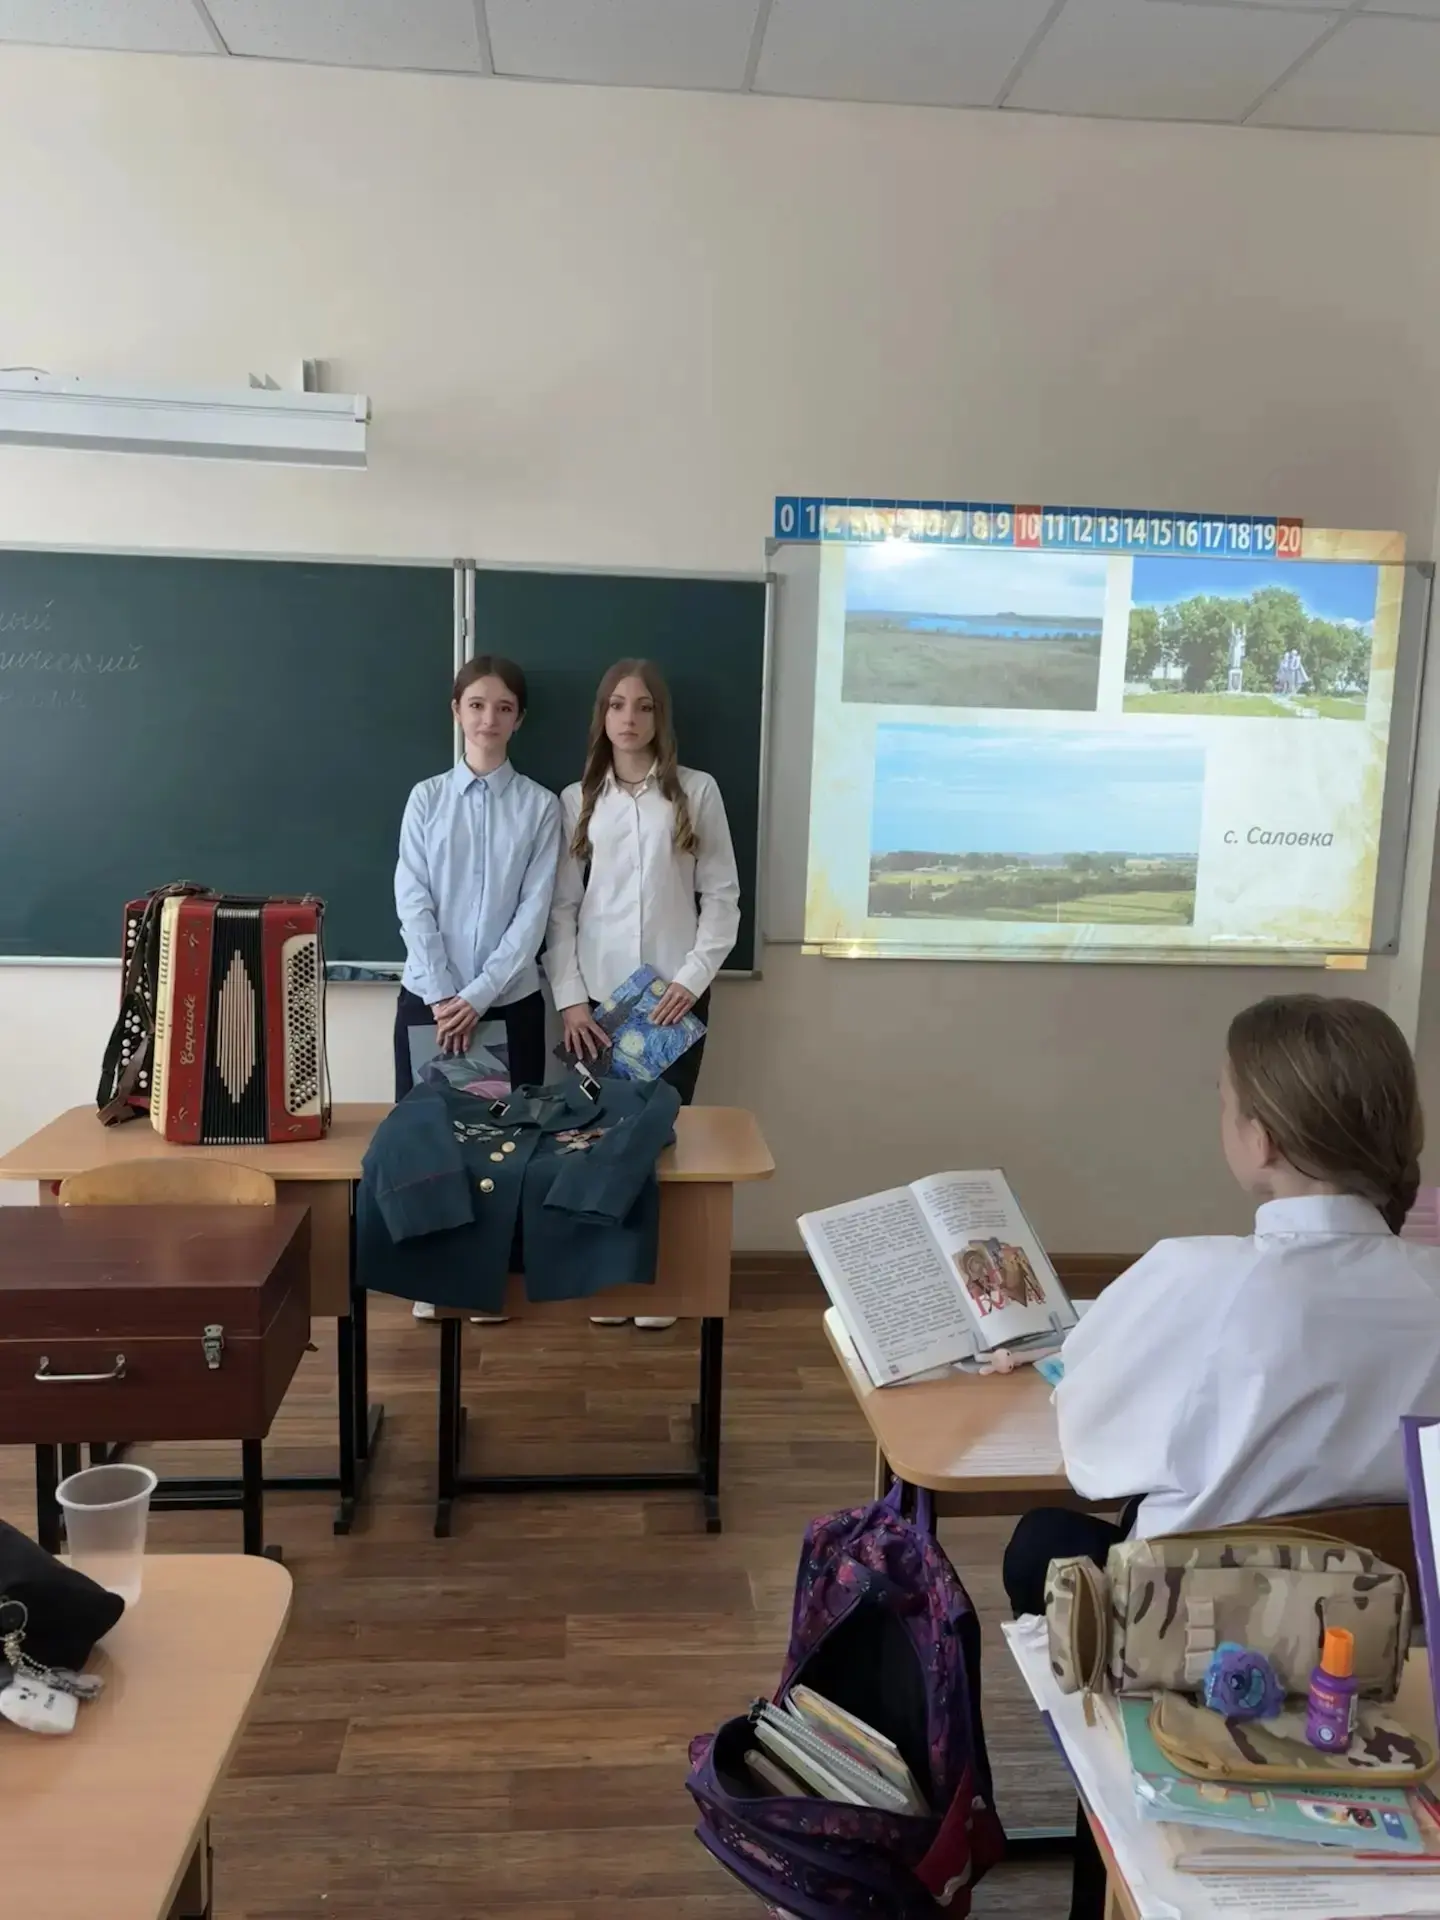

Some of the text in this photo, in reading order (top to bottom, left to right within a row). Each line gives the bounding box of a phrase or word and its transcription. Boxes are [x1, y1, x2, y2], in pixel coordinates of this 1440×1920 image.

[780, 504, 795, 532] 0
[805, 504, 816, 532] 1
[971, 511, 988, 539] 8
[996, 512, 1010, 539] 9
[1018, 513, 1038, 541] 10
[1044, 514, 1064, 541] 11
[1071, 515, 1092, 542] 12
[1098, 516, 1119, 543] 13
[1124, 518, 1146, 544] 14
[1150, 519, 1172, 546] 15
[1176, 520, 1198, 547] 16
[1202, 521, 1224, 548] 17
[1228, 523, 1250, 549] 18
[1254, 524, 1276, 550] 19
[1278, 525, 1300, 552] 20
[1223, 826, 1334, 847] с. Саловка
